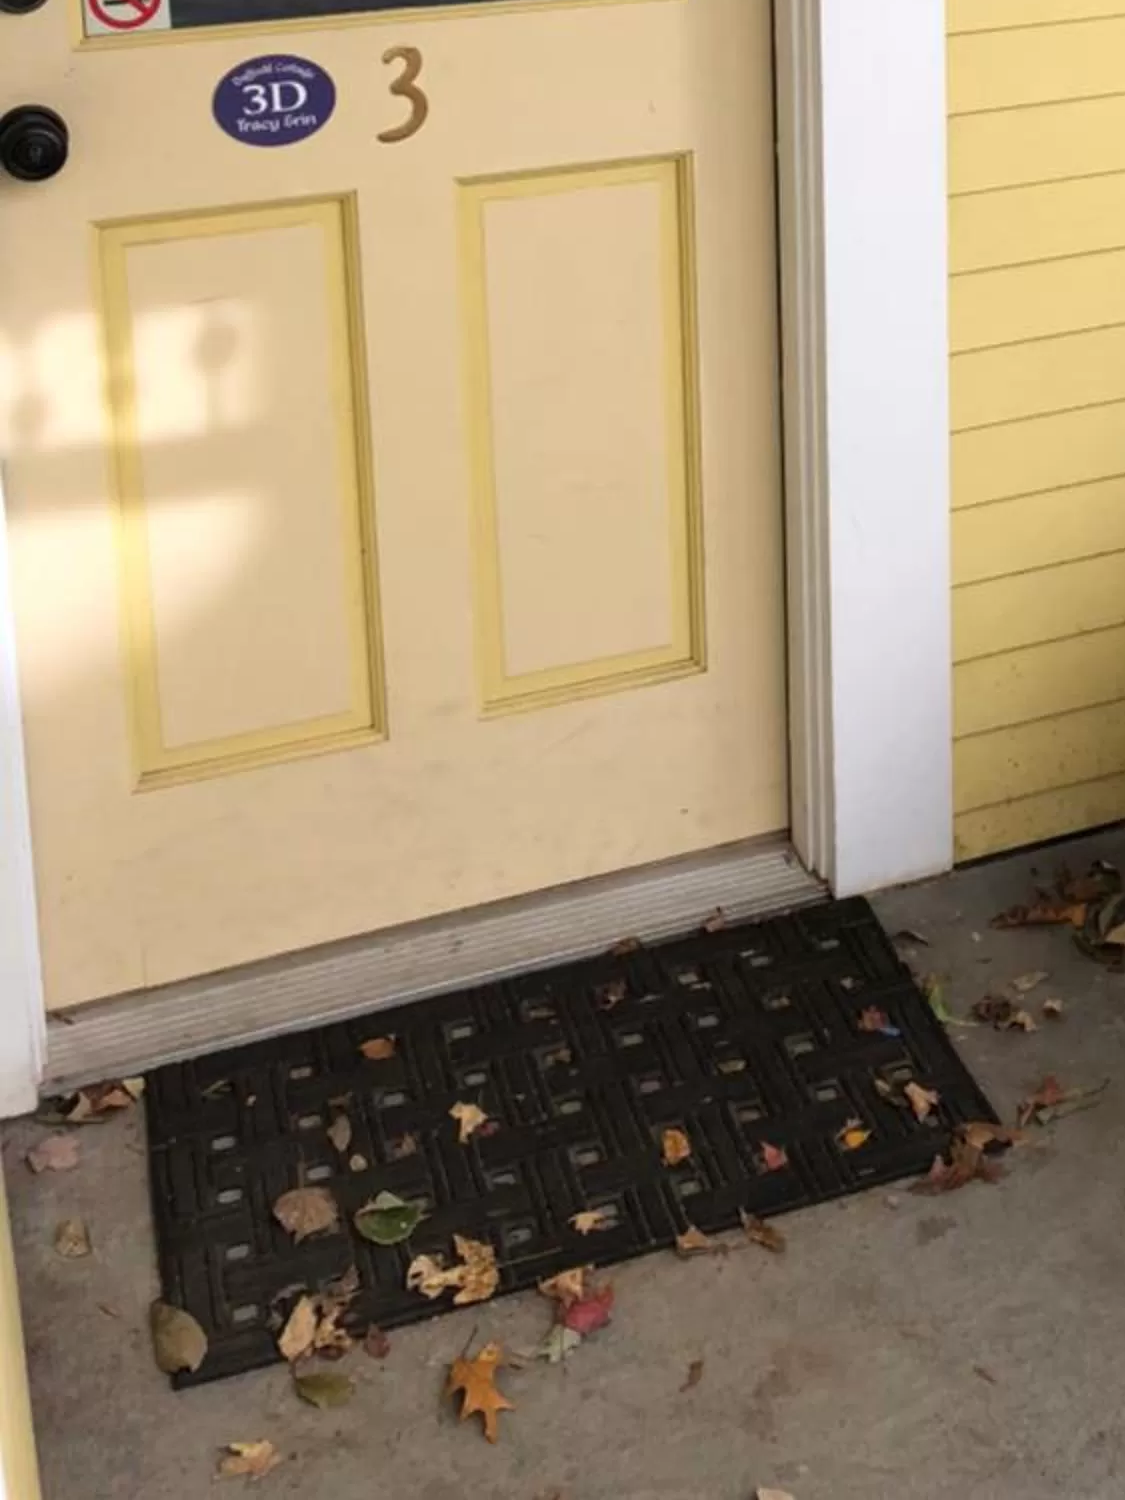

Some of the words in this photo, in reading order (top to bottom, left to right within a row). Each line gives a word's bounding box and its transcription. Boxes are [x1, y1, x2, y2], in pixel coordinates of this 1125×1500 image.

[241, 80, 308, 116] 3D
[376, 45, 429, 143] 3
[236, 116, 280, 132] Tracy
[284, 113, 317, 127] Erin
